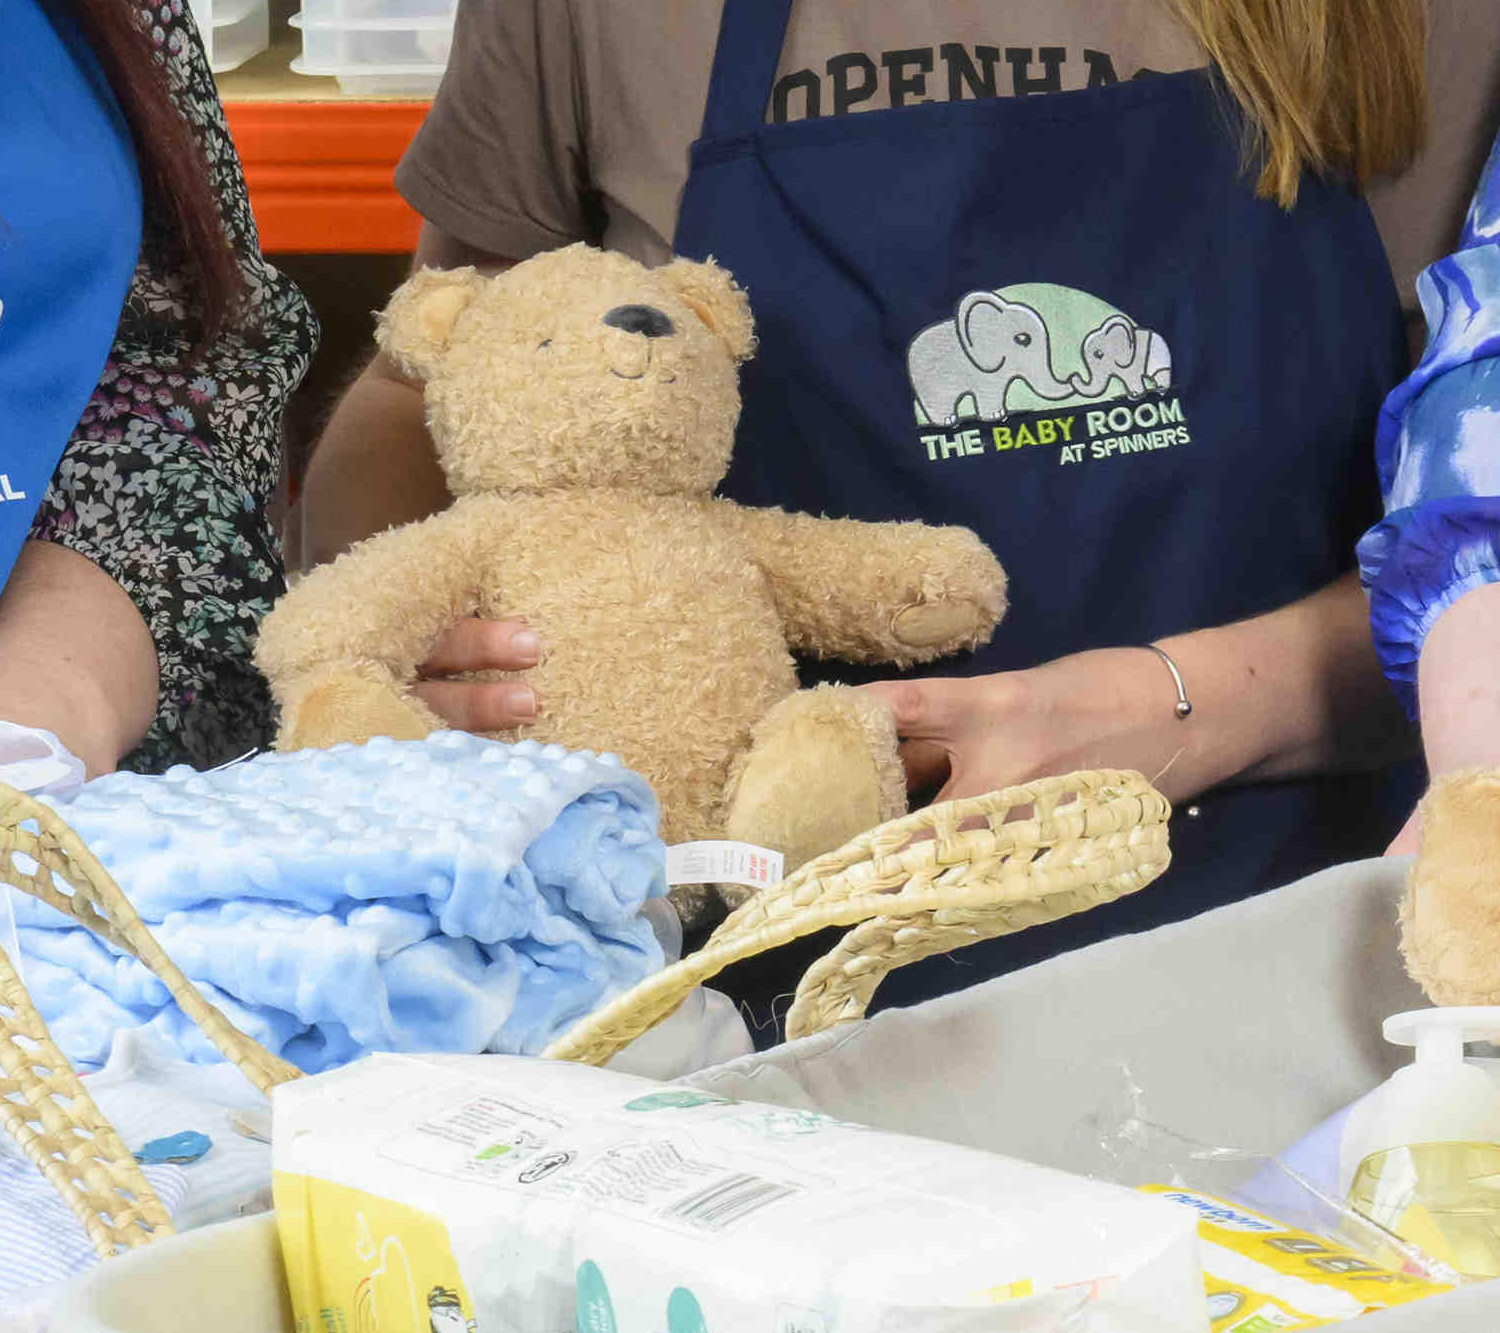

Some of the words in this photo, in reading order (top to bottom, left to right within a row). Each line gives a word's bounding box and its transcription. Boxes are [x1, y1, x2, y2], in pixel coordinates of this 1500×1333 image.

[772, 42, 1156, 124] OPENHA
[920, 429, 985, 462] THE
[992, 416, 1077, 451] BABY
[1085, 398, 1186, 437] ROOM
[1059, 443, 1086, 466] AT
[1091, 426, 1191, 460] SPINNERS
[1163, 1192, 1275, 1231] newborn
